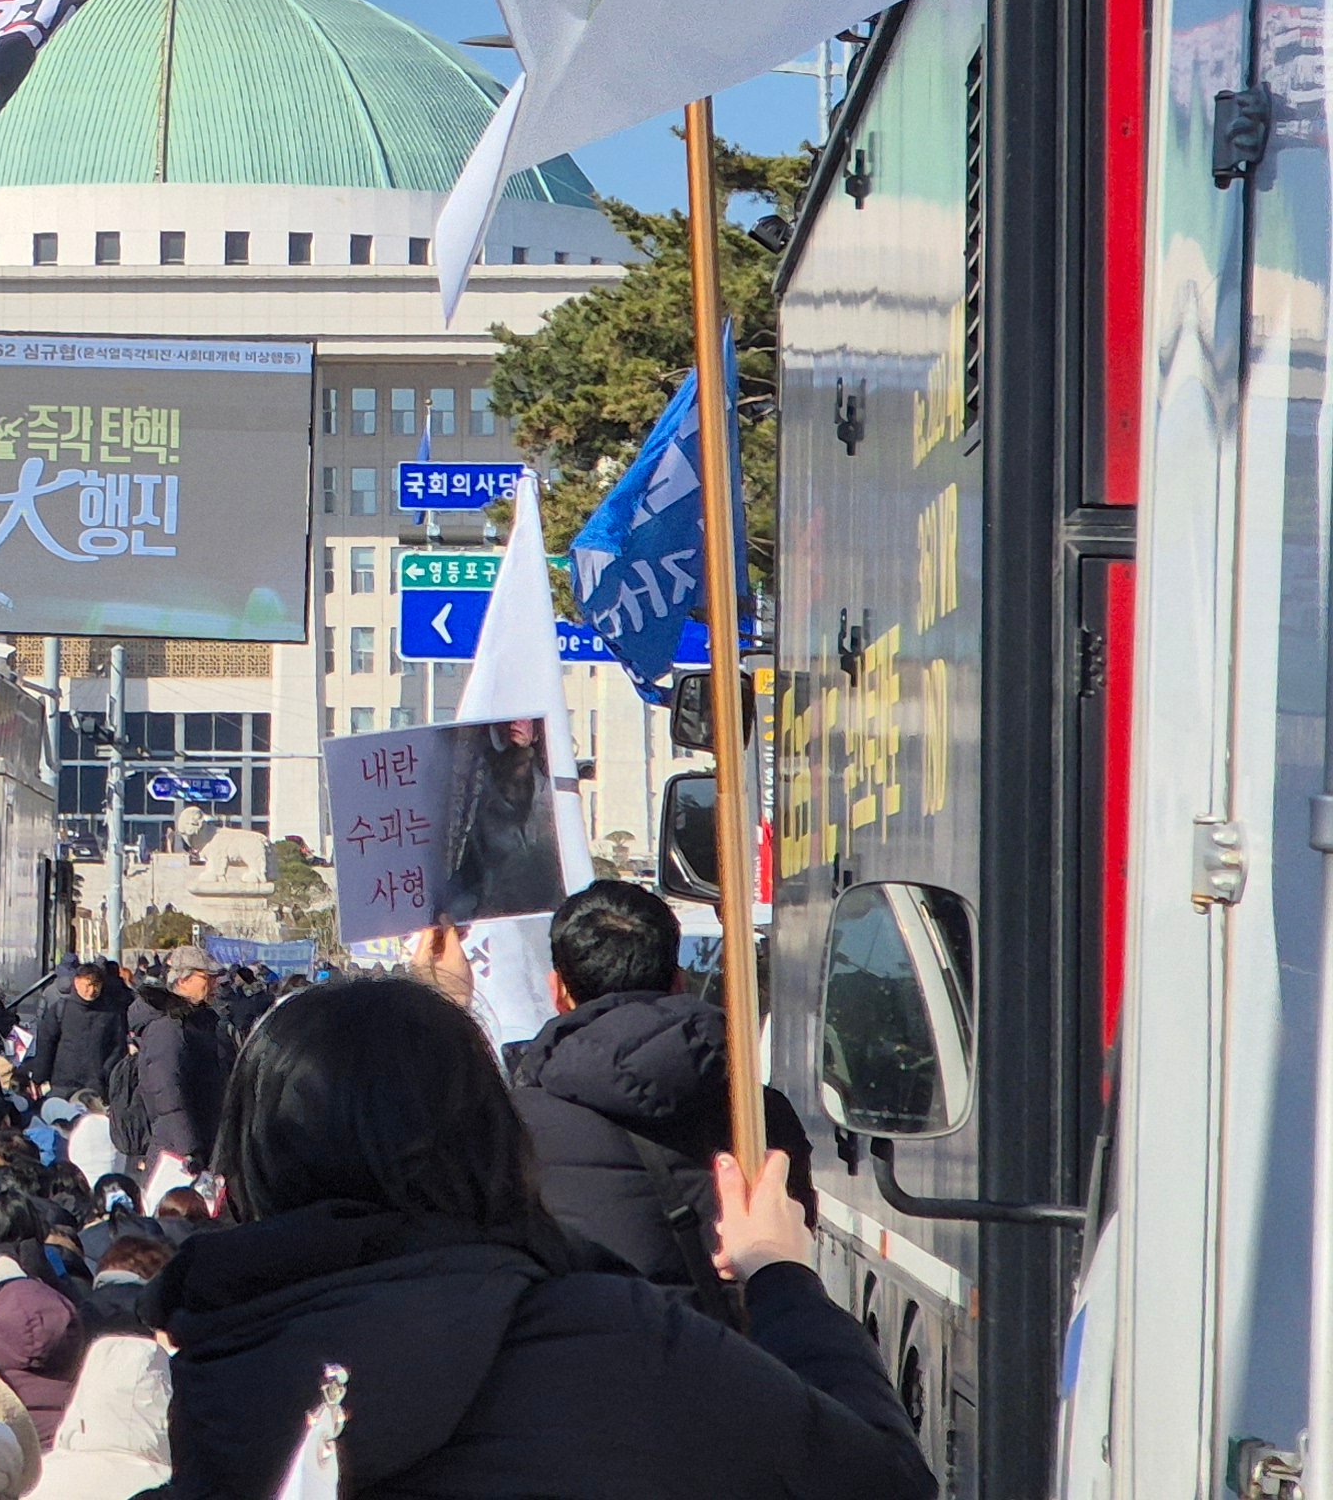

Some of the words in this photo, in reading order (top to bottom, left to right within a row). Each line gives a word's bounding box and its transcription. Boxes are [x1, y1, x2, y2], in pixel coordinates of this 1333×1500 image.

[27, 404, 94, 463] 즉각
[100, 405, 181, 466] 탄핵!
[404, 472, 518, 500] 국회의사당
[361, 744, 420, 790] 내란
[346, 807, 432, 856] 수괴는
[371, 864, 426, 913] 사형
